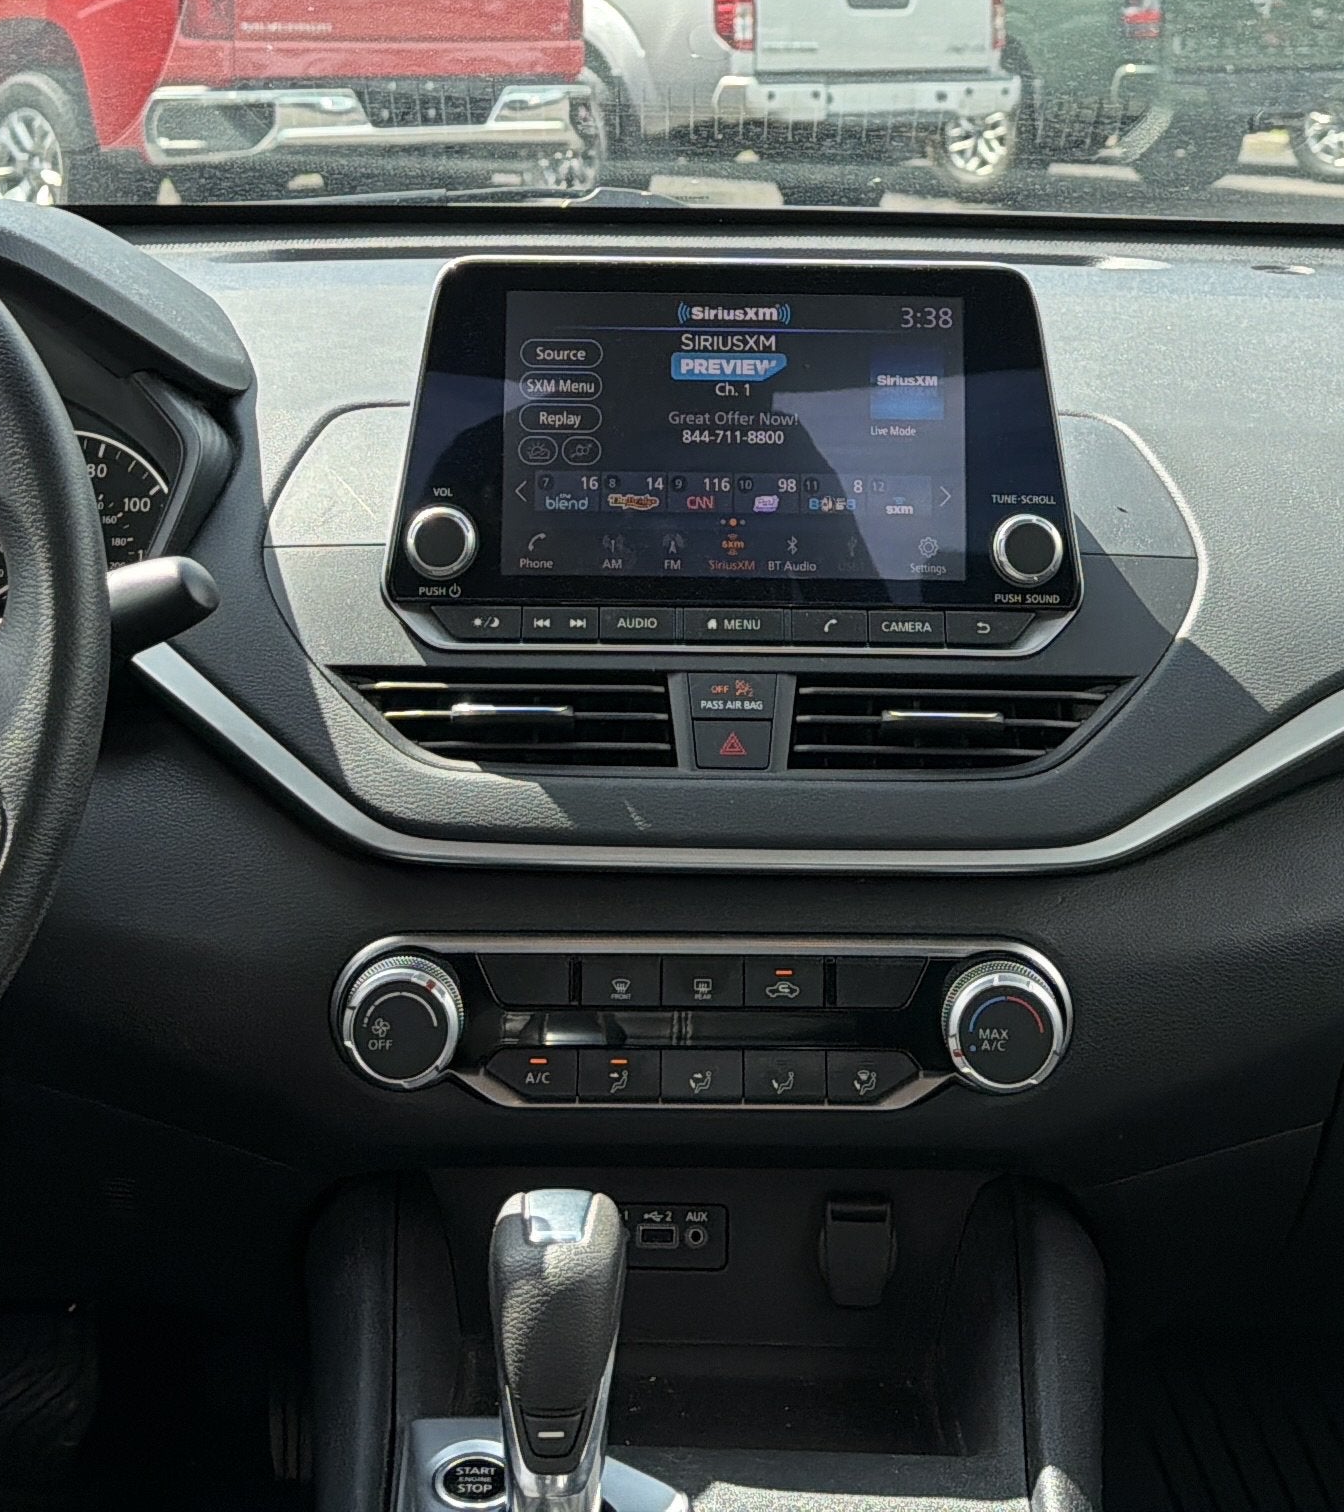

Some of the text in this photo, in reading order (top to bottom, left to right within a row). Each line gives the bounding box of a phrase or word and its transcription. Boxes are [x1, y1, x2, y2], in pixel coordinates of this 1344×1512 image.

[900, 306, 953, 329] 3:38
[680, 333, 777, 351] SIRIUSXM
[535, 346, 587, 361] Source
[680, 358, 777, 376] PREVIEW
[526, 378, 595, 393] SXM Menu
[715, 382, 750, 396] Ch. 1
[539, 411, 582, 429] Replay
[668, 411, 799, 426] Great Offer Now!
[682, 429, 785, 445] 844-711-8800
[870, 425, 917, 436] Live Mode
[581, 476, 599, 490] 16
[646, 476, 664, 491] 14
[703, 477, 731, 492] 116
[777, 478, 797, 493] 98
[853, 479, 863, 494] 8
[432, 487, 453, 497] VOL
[122, 497, 152, 513] 100
[545, 496, 589, 510] blend
[686, 496, 715, 509] CNN
[111, 537, 127, 547] 180
[519, 557, 554, 569] Phone
[602, 559, 623, 569] AM
[664, 559, 681, 570] FM
[767, 560, 817, 572] BT Audio
[910, 562, 947, 576] Settings
[418, 586, 447, 596] PUSH
[994, 593, 1060, 604] PUSH SOUND
[616, 617, 658, 629] AUDIO
[723, 618, 761, 630] MENU
[881, 621, 932, 633] CAMERA
[711, 684, 730, 694] OFF
[700, 700, 763, 711] PASS AIR BAG
[978, 1028, 1009, 1040] MAX
[367, 1038, 393, 1051] OFF
[981, 1040, 1006, 1052] A/C
[525, 1071, 551, 1085] A/C
[686, 1211, 709, 1222] AUX
[455, 1466, 497, 1477] START
[457, 1483, 493, 1495] STOP
